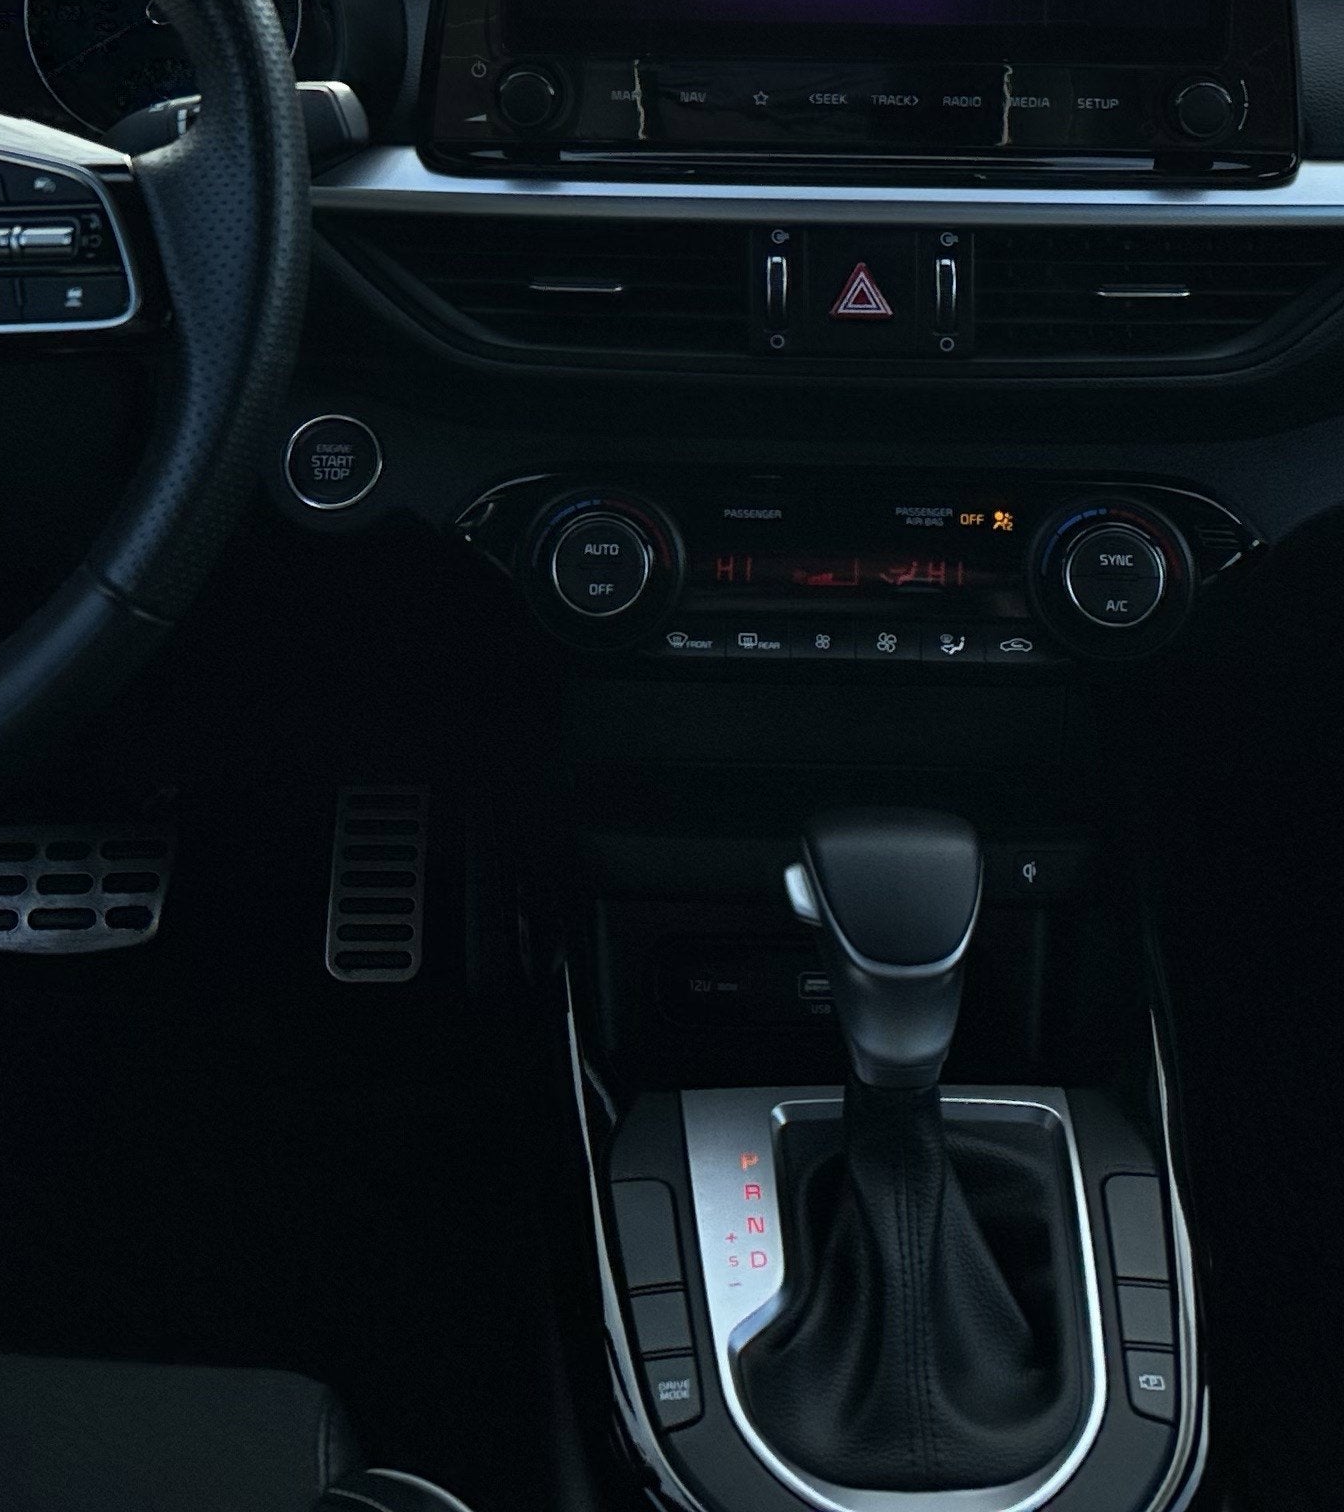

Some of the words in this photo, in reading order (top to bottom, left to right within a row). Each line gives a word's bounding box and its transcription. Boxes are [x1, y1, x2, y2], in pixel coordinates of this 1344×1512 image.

[680, 91, 706, 104] NAV
[942, 95, 982, 108] RADIO
[1009, 96, 1050, 109] MEDIA
[1077, 97, 1120, 110] SETUP
[311, 454, 354, 468] START
[313, 468, 350, 480] STOP
[723, 508, 782, 520] PASSENGER
[895, 507, 954, 518] PASSENGER
[960, 513, 985, 526] OFF
[583, 542, 620, 556] AUTO
[1099, 553, 1135, 567] SYNC
[588, 582, 614, 596] OFF
[1105, 599, 1128, 612] A/C
[685, 639, 713, 649] FRONT
[758, 640, 781, 650] REAR
[740, 1152, 759, 1170] P
[745, 1184, 761, 1200] R
[747, 1217, 764, 1234] N
[729, 1255, 739, 1267] S
[750, 1251, 767, 1268] D
